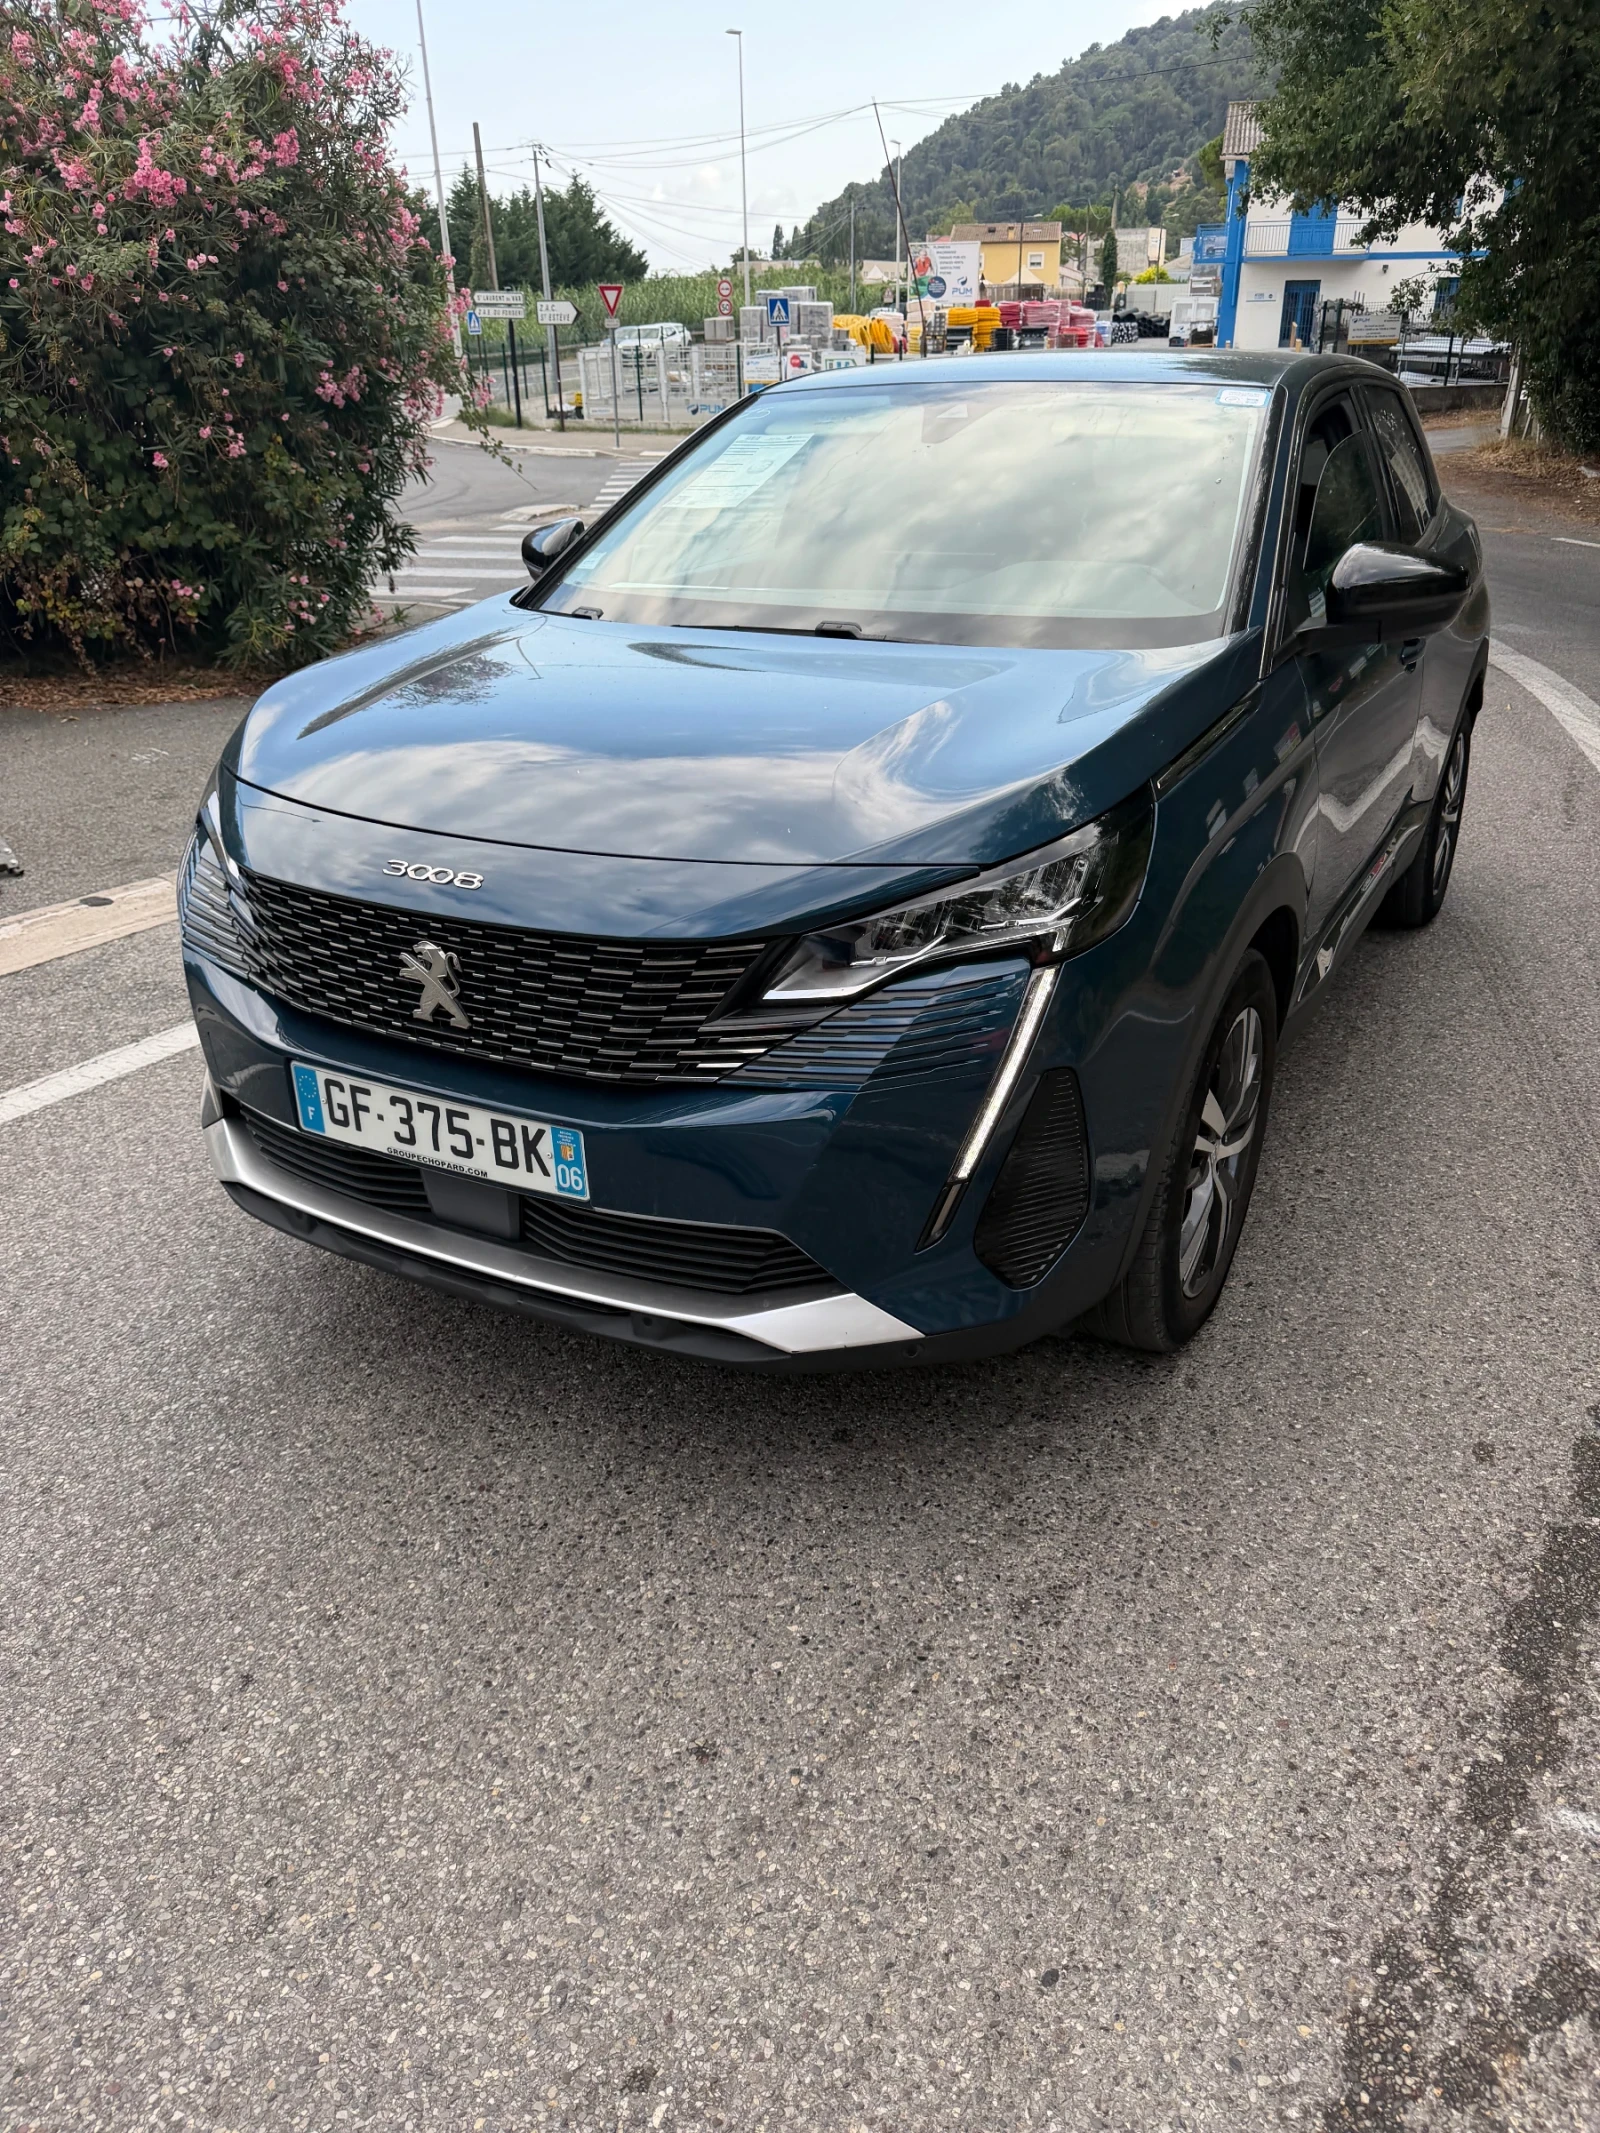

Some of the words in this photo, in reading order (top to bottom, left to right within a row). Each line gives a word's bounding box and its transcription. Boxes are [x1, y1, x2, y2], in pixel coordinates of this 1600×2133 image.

[721, 303, 729, 311] 50
[382, 858, 484, 890] 3008
[307, 1105, 316, 1121] F
[323, 1077, 552, 1178] GF-375-BK
[386, 1146, 488, 1179] GROUPECHOPARD.COM
[557, 1163, 583, 1191] 06
